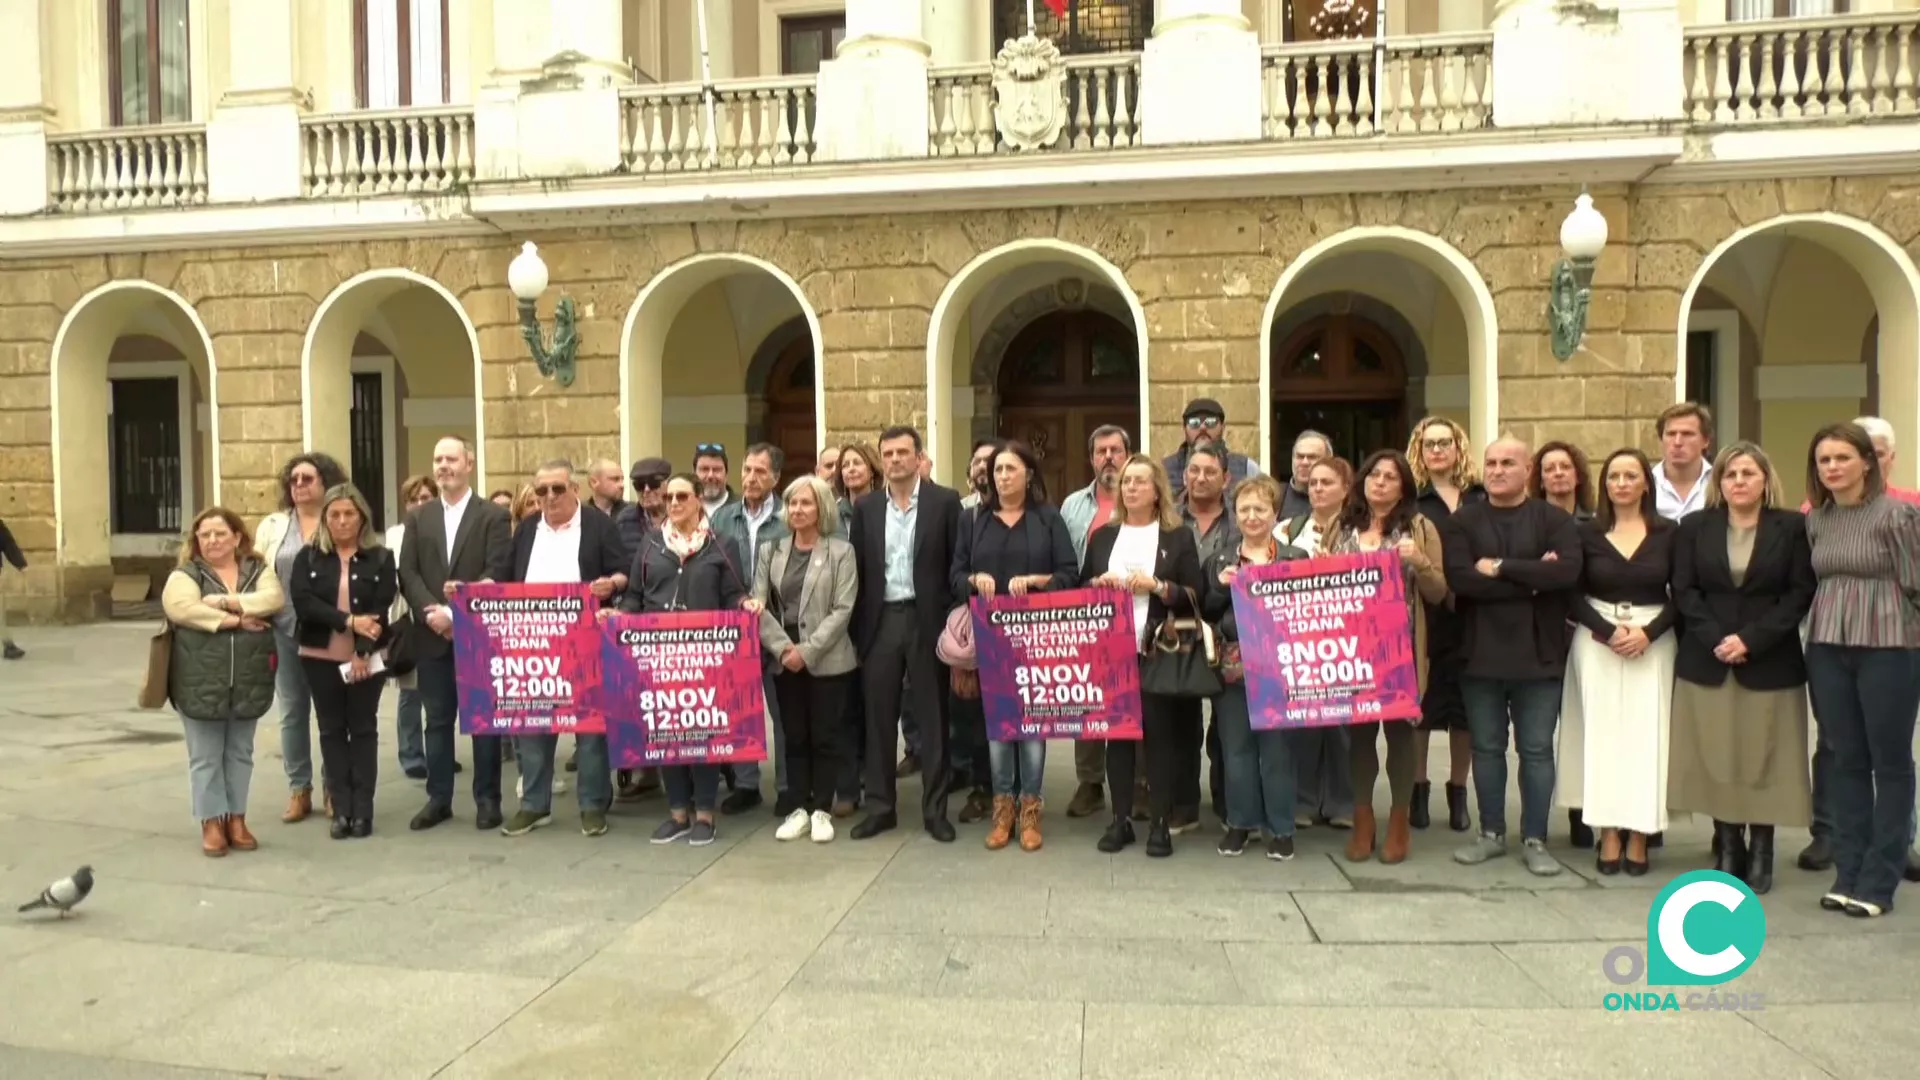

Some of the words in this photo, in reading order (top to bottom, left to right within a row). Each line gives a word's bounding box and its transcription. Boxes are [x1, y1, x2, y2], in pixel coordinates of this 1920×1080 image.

[1251, 568, 1380, 595] Concentración
[470, 596, 581, 611] Concentración
[1264, 584, 1376, 609] SOLIDARIDAD
[482, 612, 578, 624] SOLIDARIDAD
[991, 603, 1113, 624] Concentración
[1004, 618, 1109, 636] SOLIDARIDAD
[1297, 616, 1344, 634] DANA
[510, 638, 550, 649] DANA
[620, 626, 738, 644] Concentración
[632, 642, 735, 657] SOLIDARIDAD
[1034, 647, 1079, 659] DANA
[1277, 636, 1358, 665] 8NOV
[490, 656, 560, 677] 8NOV
[660, 669, 704, 682] DANA
[1014, 663, 1090, 685] 8NOV
[1281, 658, 1373, 686] 12:00h
[492, 676, 572, 698] 12:00h
[1018, 682, 1103, 704] 12:00h
[640, 686, 716, 711] 8NOV
[493, 716, 512, 728] UGT
[642, 706, 728, 730] 12:00h
[1286, 708, 1307, 720] UGT
[1021, 723, 1041, 734] UGT
[645, 749, 665, 760] UGT
